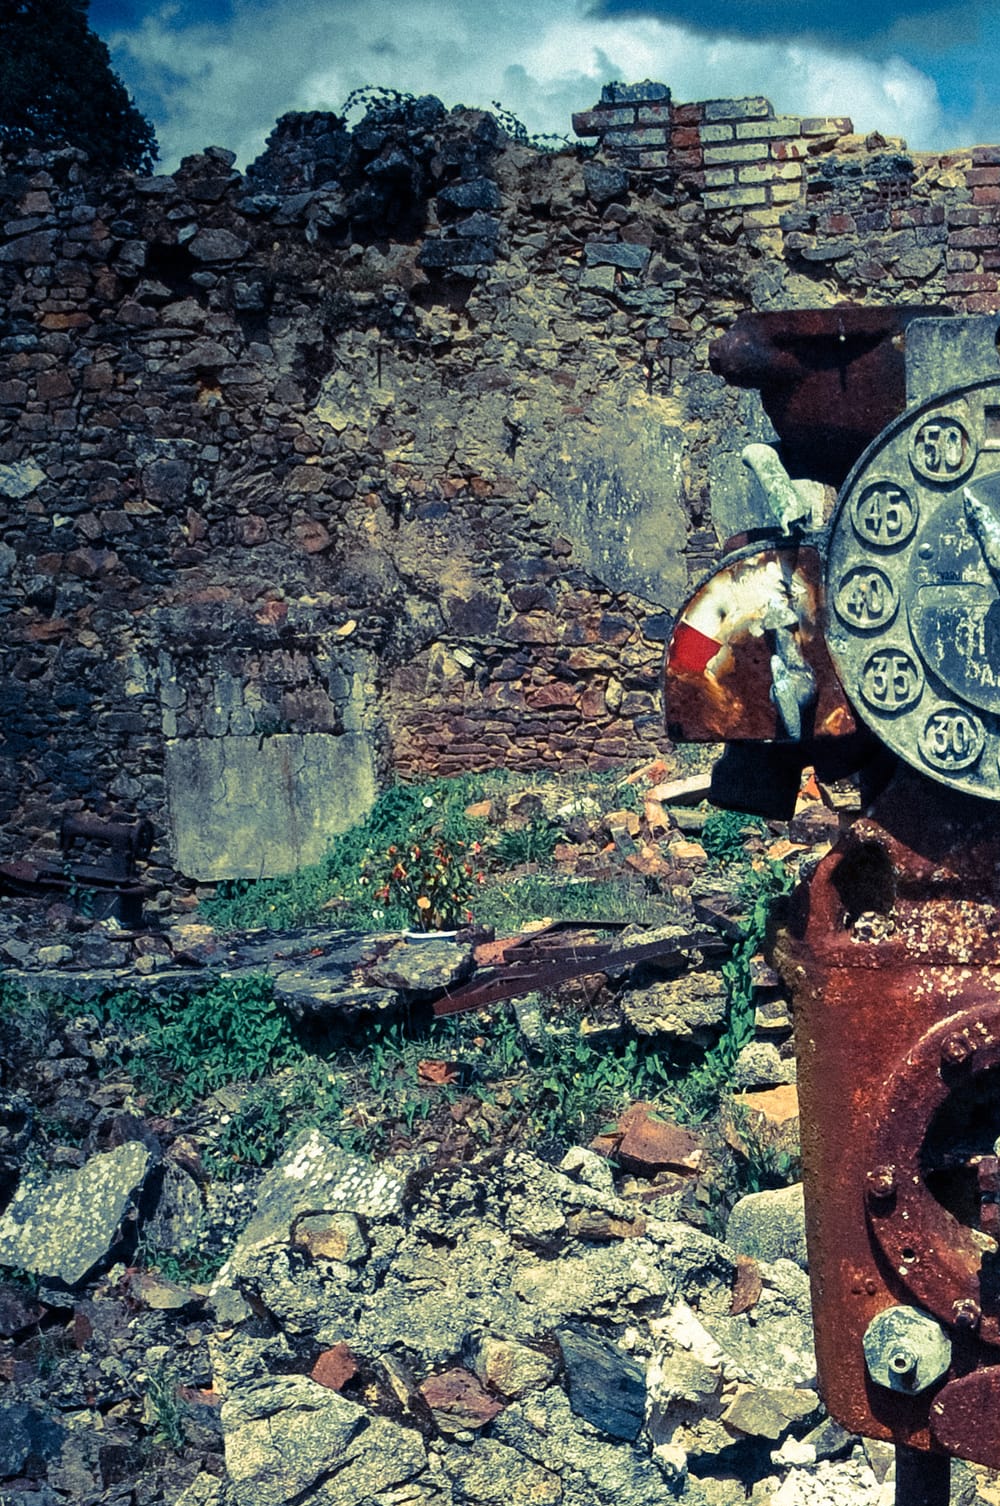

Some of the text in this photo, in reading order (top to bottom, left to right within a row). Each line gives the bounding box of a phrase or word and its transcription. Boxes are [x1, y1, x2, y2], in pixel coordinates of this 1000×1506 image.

[921, 425, 963, 470] 50
[864, 491, 903, 535] 45
[848, 574, 884, 617] 40
[872, 656, 909, 699] 35
[933, 715, 969, 756] 30
